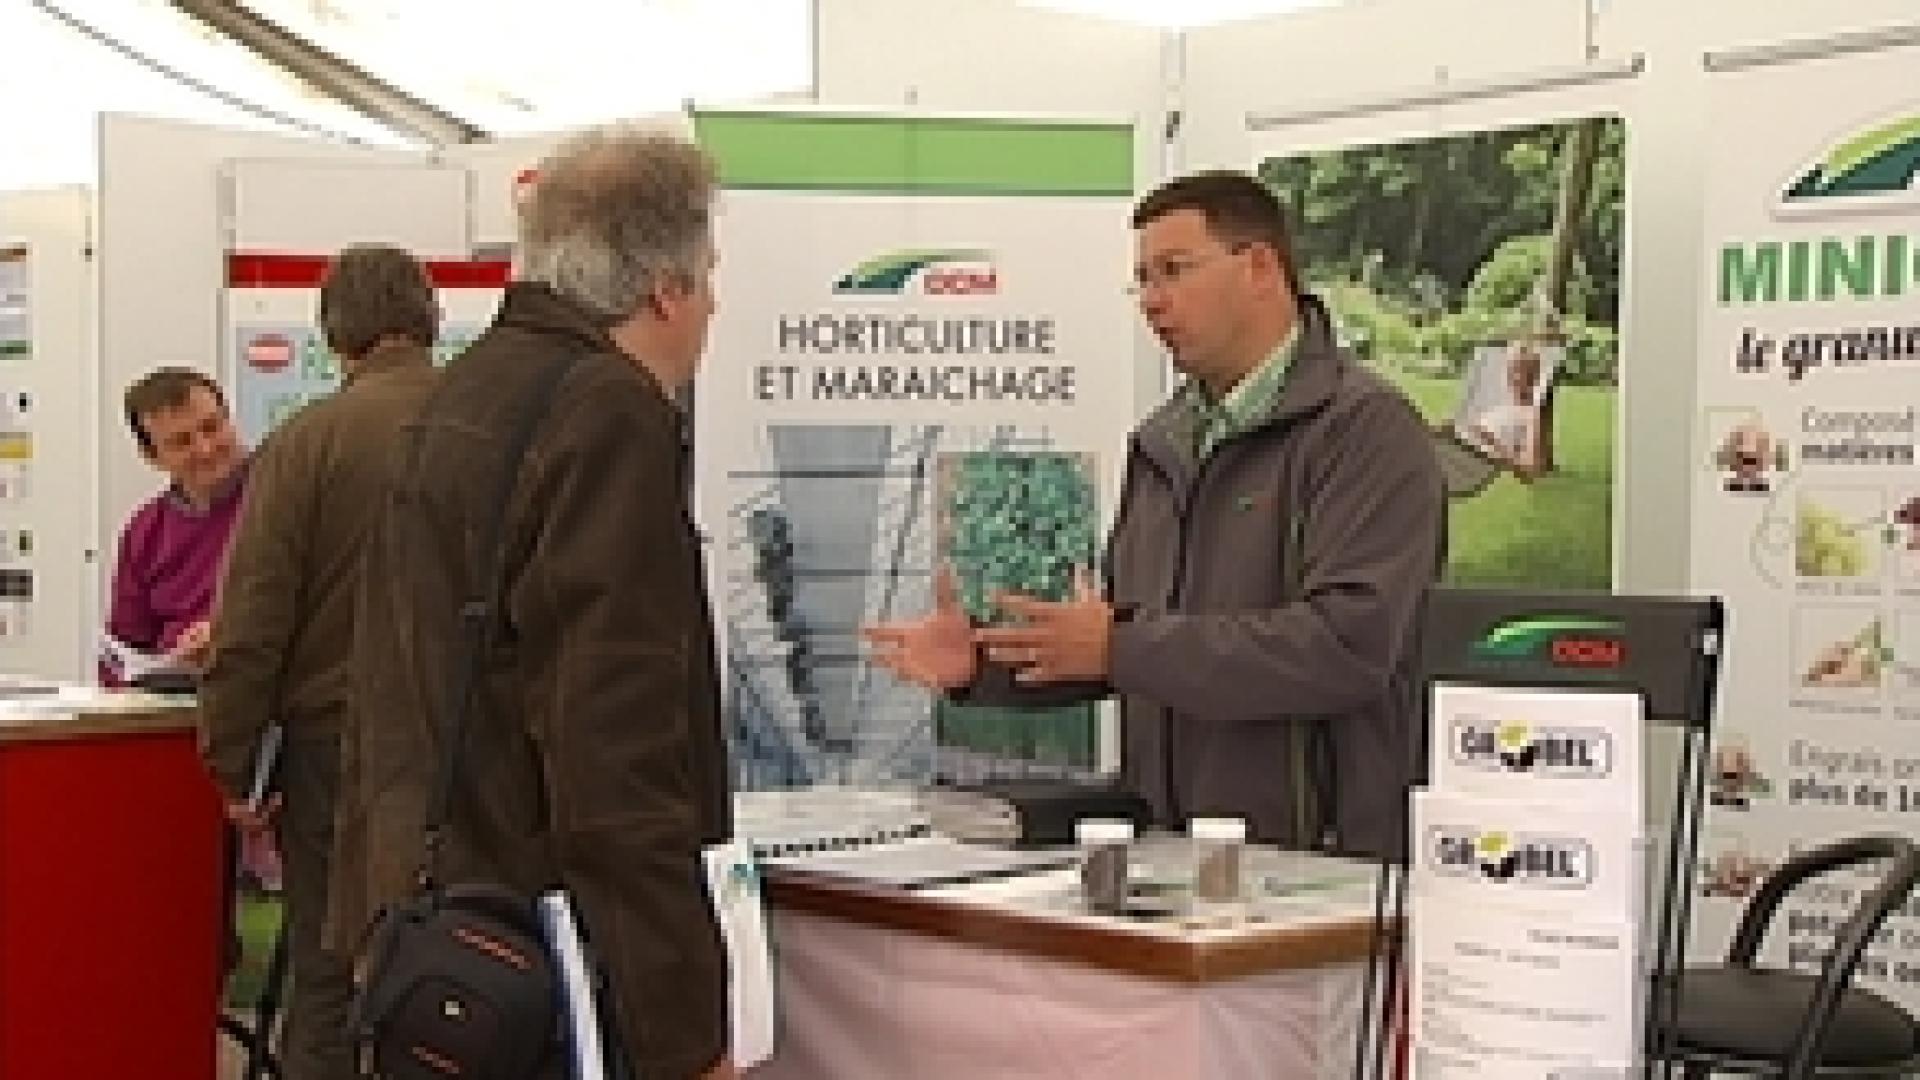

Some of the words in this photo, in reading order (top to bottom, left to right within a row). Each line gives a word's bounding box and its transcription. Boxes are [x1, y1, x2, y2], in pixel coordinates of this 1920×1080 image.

[1717, 234, 1920, 306] MINI
[777, 315, 1056, 354] HORTICULTURE
[1736, 327, 1774, 373] le
[754, 365, 799, 401] ET
[811, 365, 1077, 402] MARAICHAGE
[1788, 773, 1849, 806] plus
